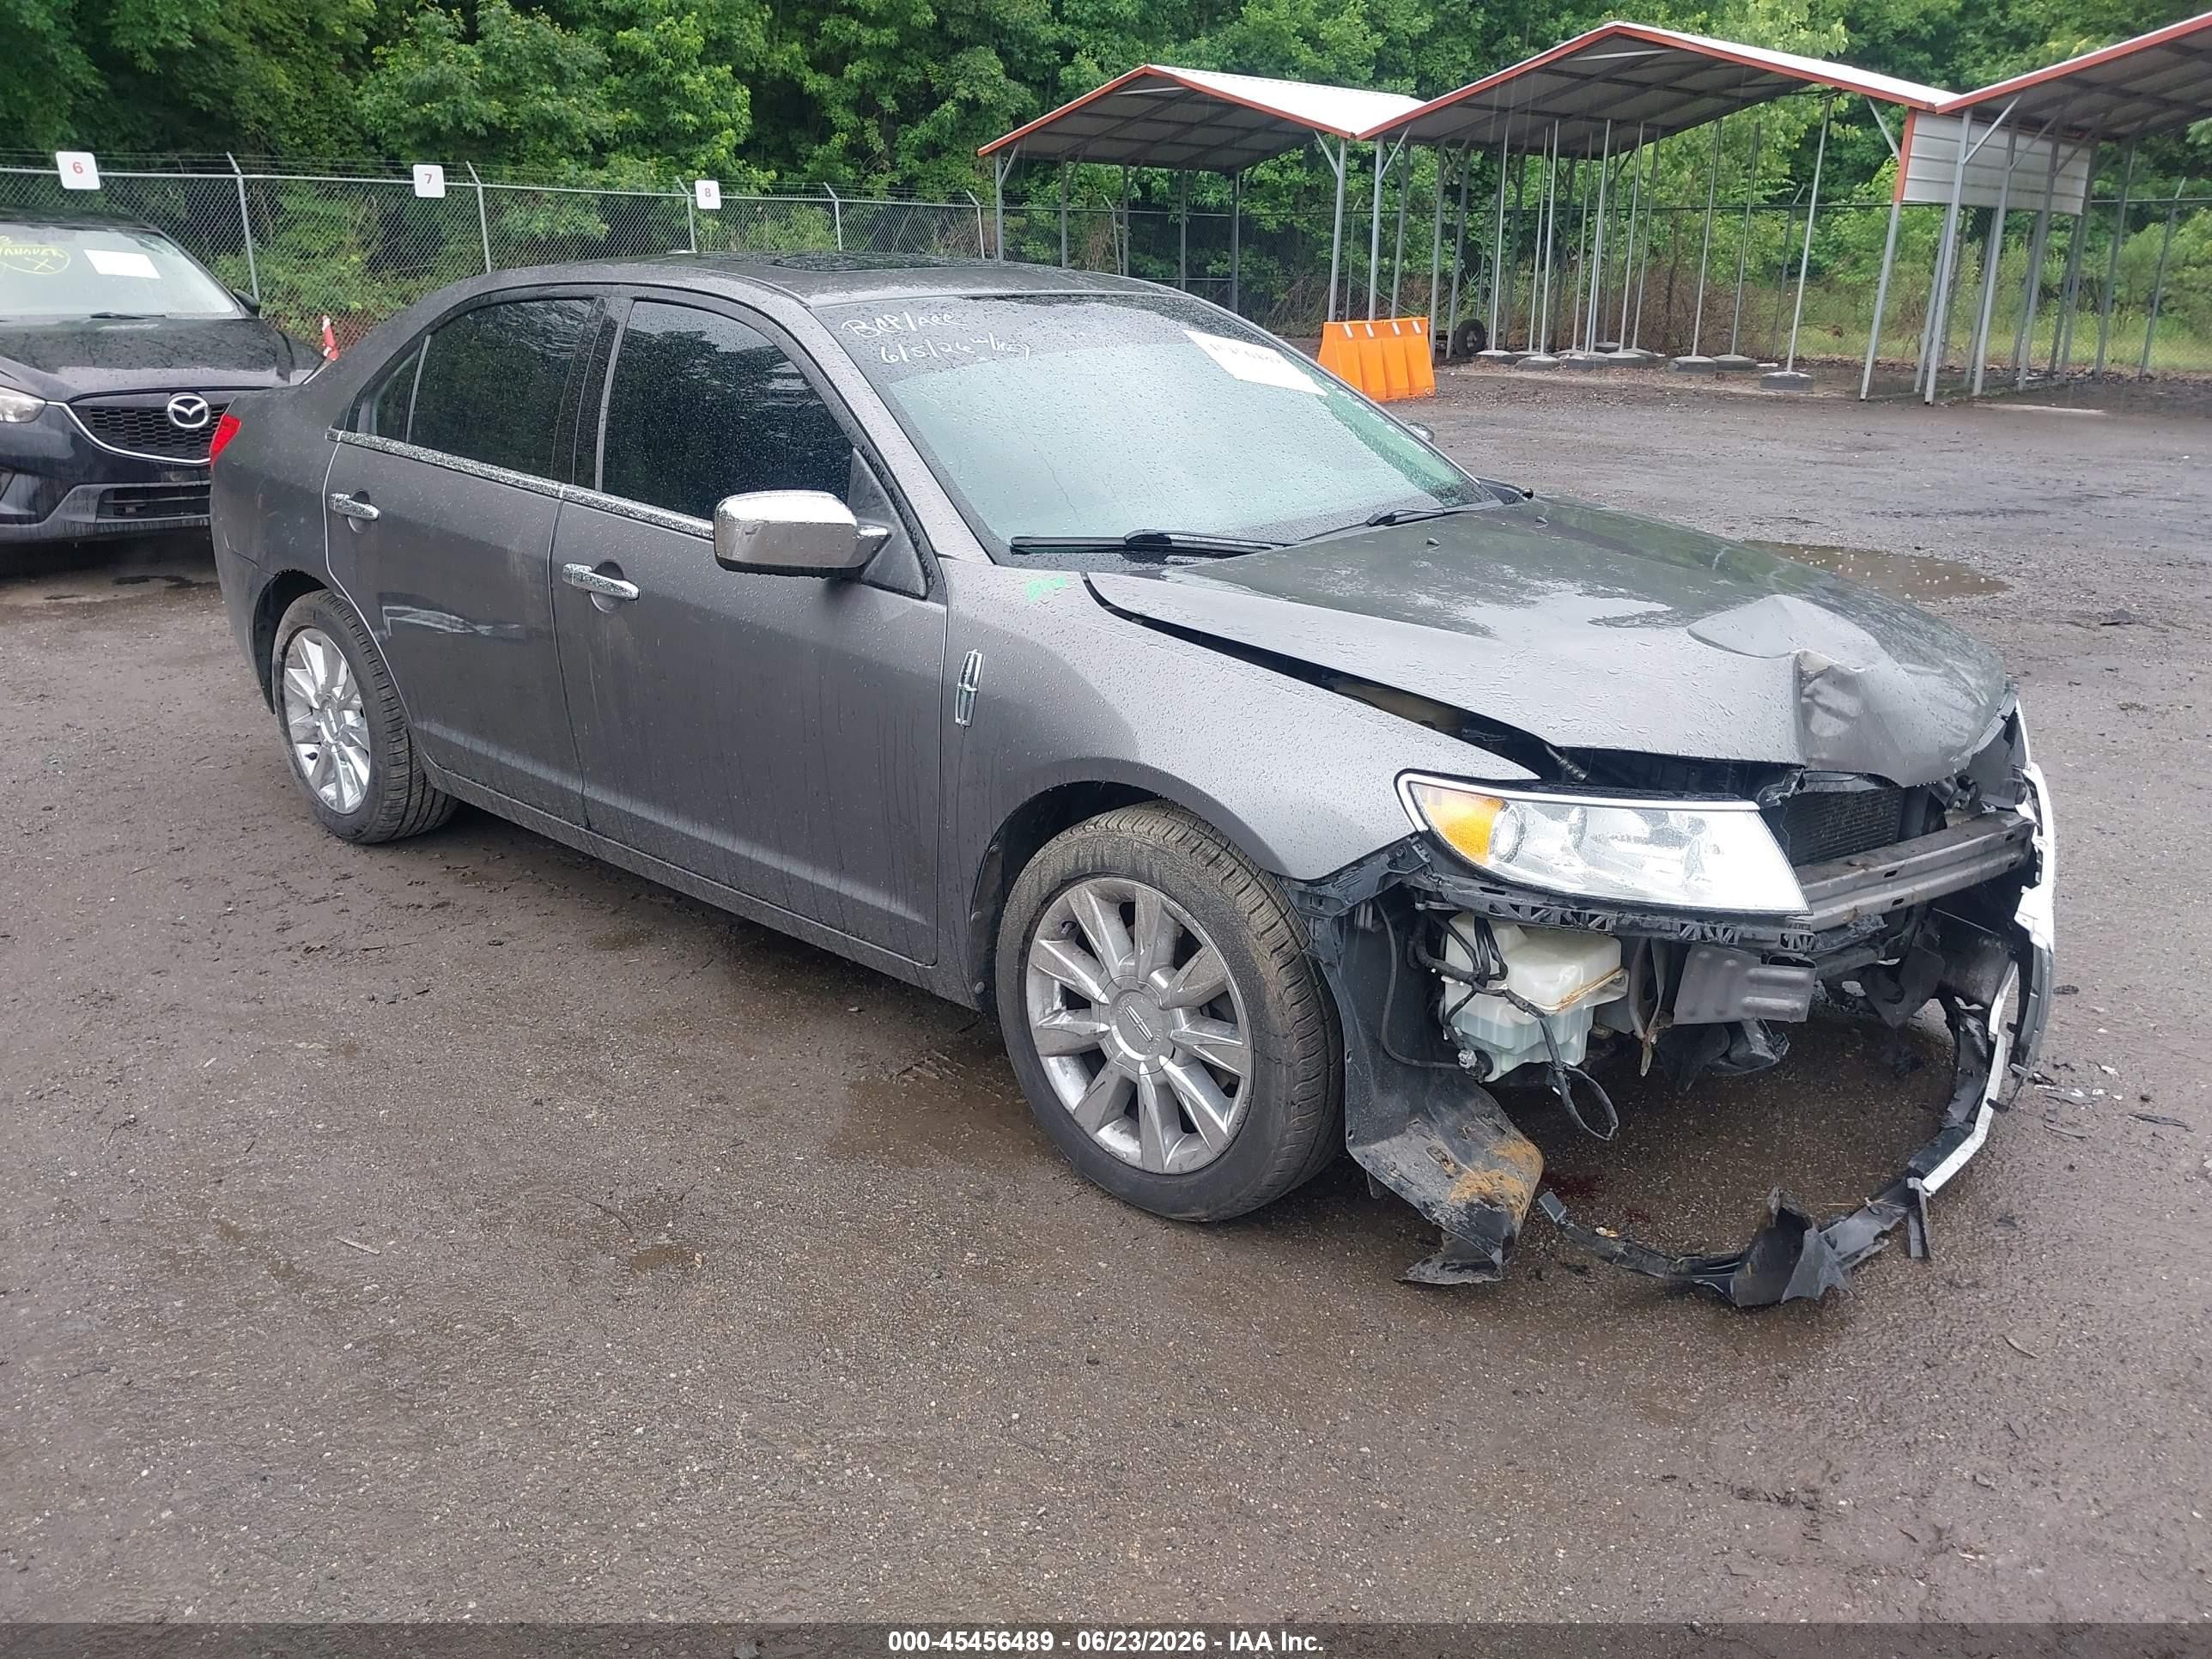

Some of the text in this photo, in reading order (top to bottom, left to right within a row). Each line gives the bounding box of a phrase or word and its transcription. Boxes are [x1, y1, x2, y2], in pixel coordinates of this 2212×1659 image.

[73, 161, 83, 174] 6
[424, 173, 432, 184] 7
[704, 187, 712, 198] 8
